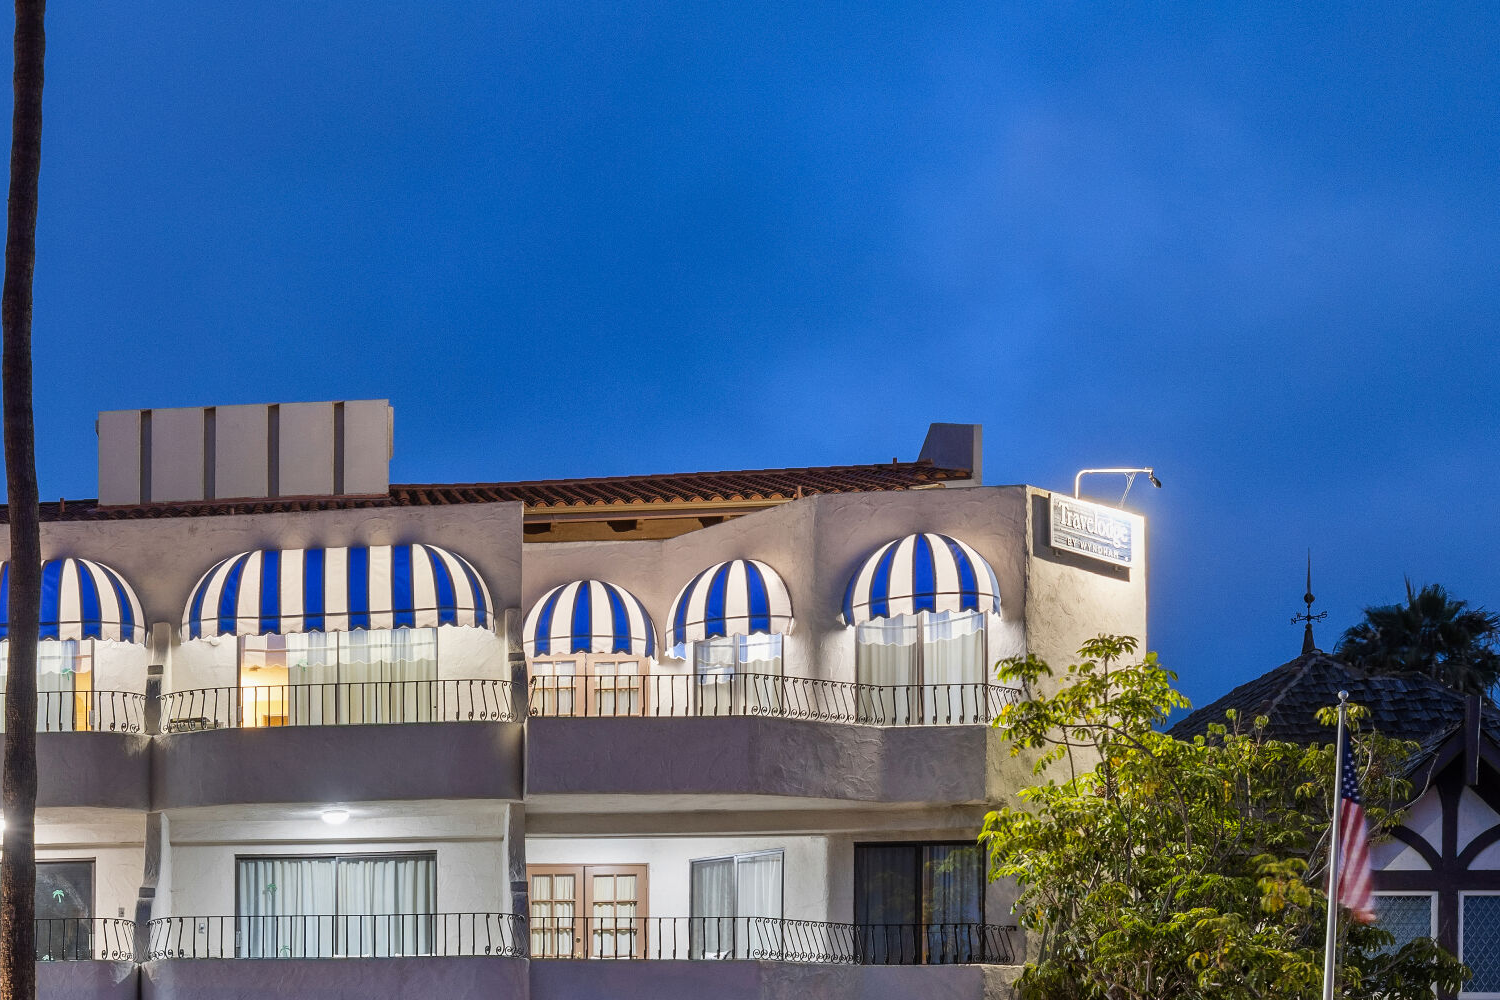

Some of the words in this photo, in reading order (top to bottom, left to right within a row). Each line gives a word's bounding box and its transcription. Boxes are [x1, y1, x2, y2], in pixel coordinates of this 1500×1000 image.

[1058, 501, 1128, 548] Travelodge
[1067, 537, 1076, 547] BY
[1080, 541, 1119, 559] WYNDHAM
